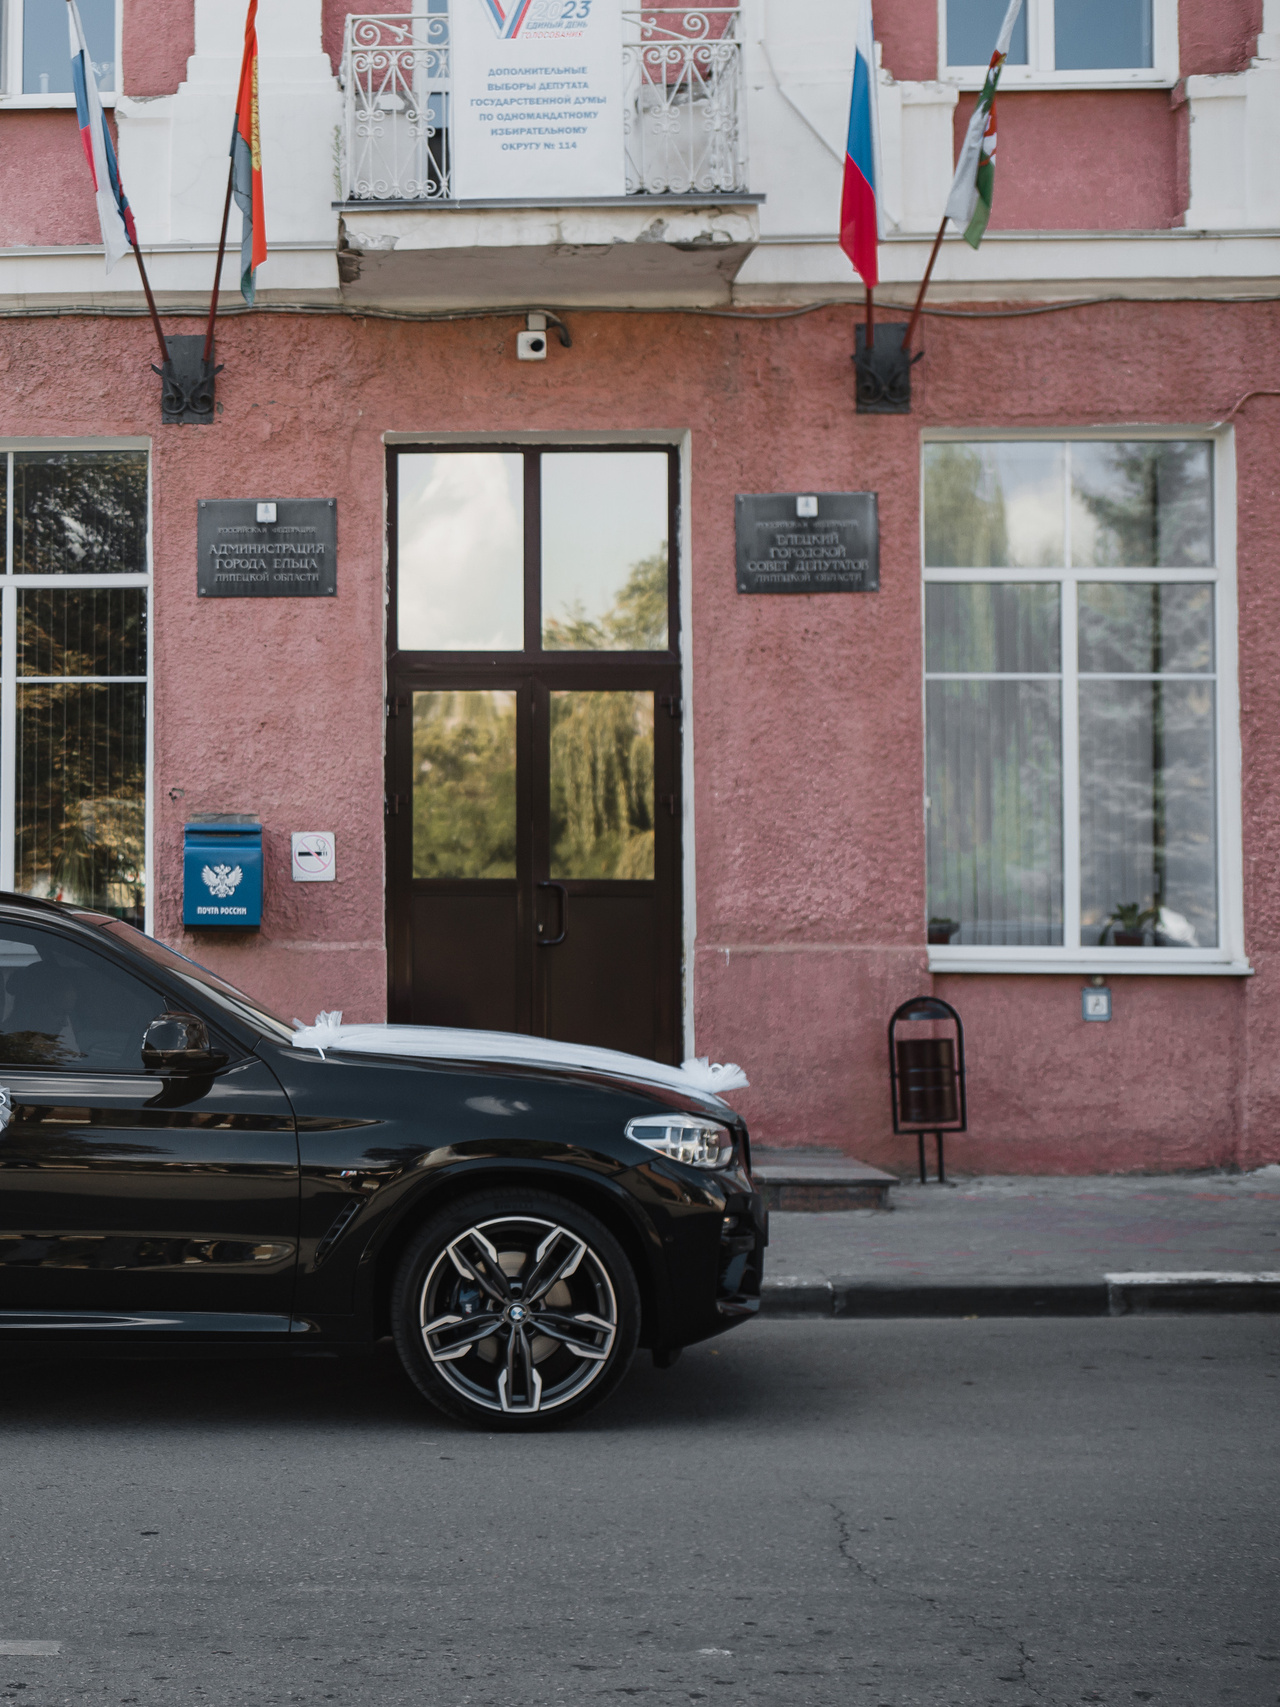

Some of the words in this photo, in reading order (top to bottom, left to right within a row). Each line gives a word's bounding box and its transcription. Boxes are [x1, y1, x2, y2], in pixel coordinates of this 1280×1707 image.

[530, 0, 592, 20] 2023
[526, 20, 563, 30] ЕДИНЫЙ
[564, 20, 588, 29] ДЕНЬ
[521, 31, 584, 39] ГОЛОСОВАНИЯ
[488, 66, 588, 77] ДОПОЛНИТЕЛЬНЫЕ
[487, 83, 536, 91] ВЫБОРЫ
[538, 81, 589, 91] ДЕПУТАТА
[470, 95, 572, 107] ГОСУДАРСТВЕННОЙ
[573, 96, 607, 105] ДУМЫ
[480, 113, 494, 121] ПО
[496, 111, 599, 122] ОДНОМАНДАТНОМУ
[490, 127, 588, 136] ИЗБИРАТЕЛЬНОМУ
[501, 142, 541, 151] ОКРУГУ
[543, 142, 556, 150] №
[558, 142, 577, 150] 114
[776, 532, 839, 546] ЕЛЕЦКИЙ
[210, 543, 325, 556] АДМИНИСТРАЦИЯ
[770, 545, 846, 558] ГОРОДСКОЙ
[216, 559, 267, 570] ГОРОДА
[273, 558, 318, 570] ЕЛЬЦА
[748, 561, 789, 571] СОВЕТ
[795, 559, 869, 571] ДЕПУТАТОВ
[215, 572, 269, 583] ЛИПЕЦКОЙ
[273, 573, 319, 582] ОБЛАСТИ
[197, 906, 219, 915] ПОЧТА
[220, 906, 247, 915] РОССИИ
